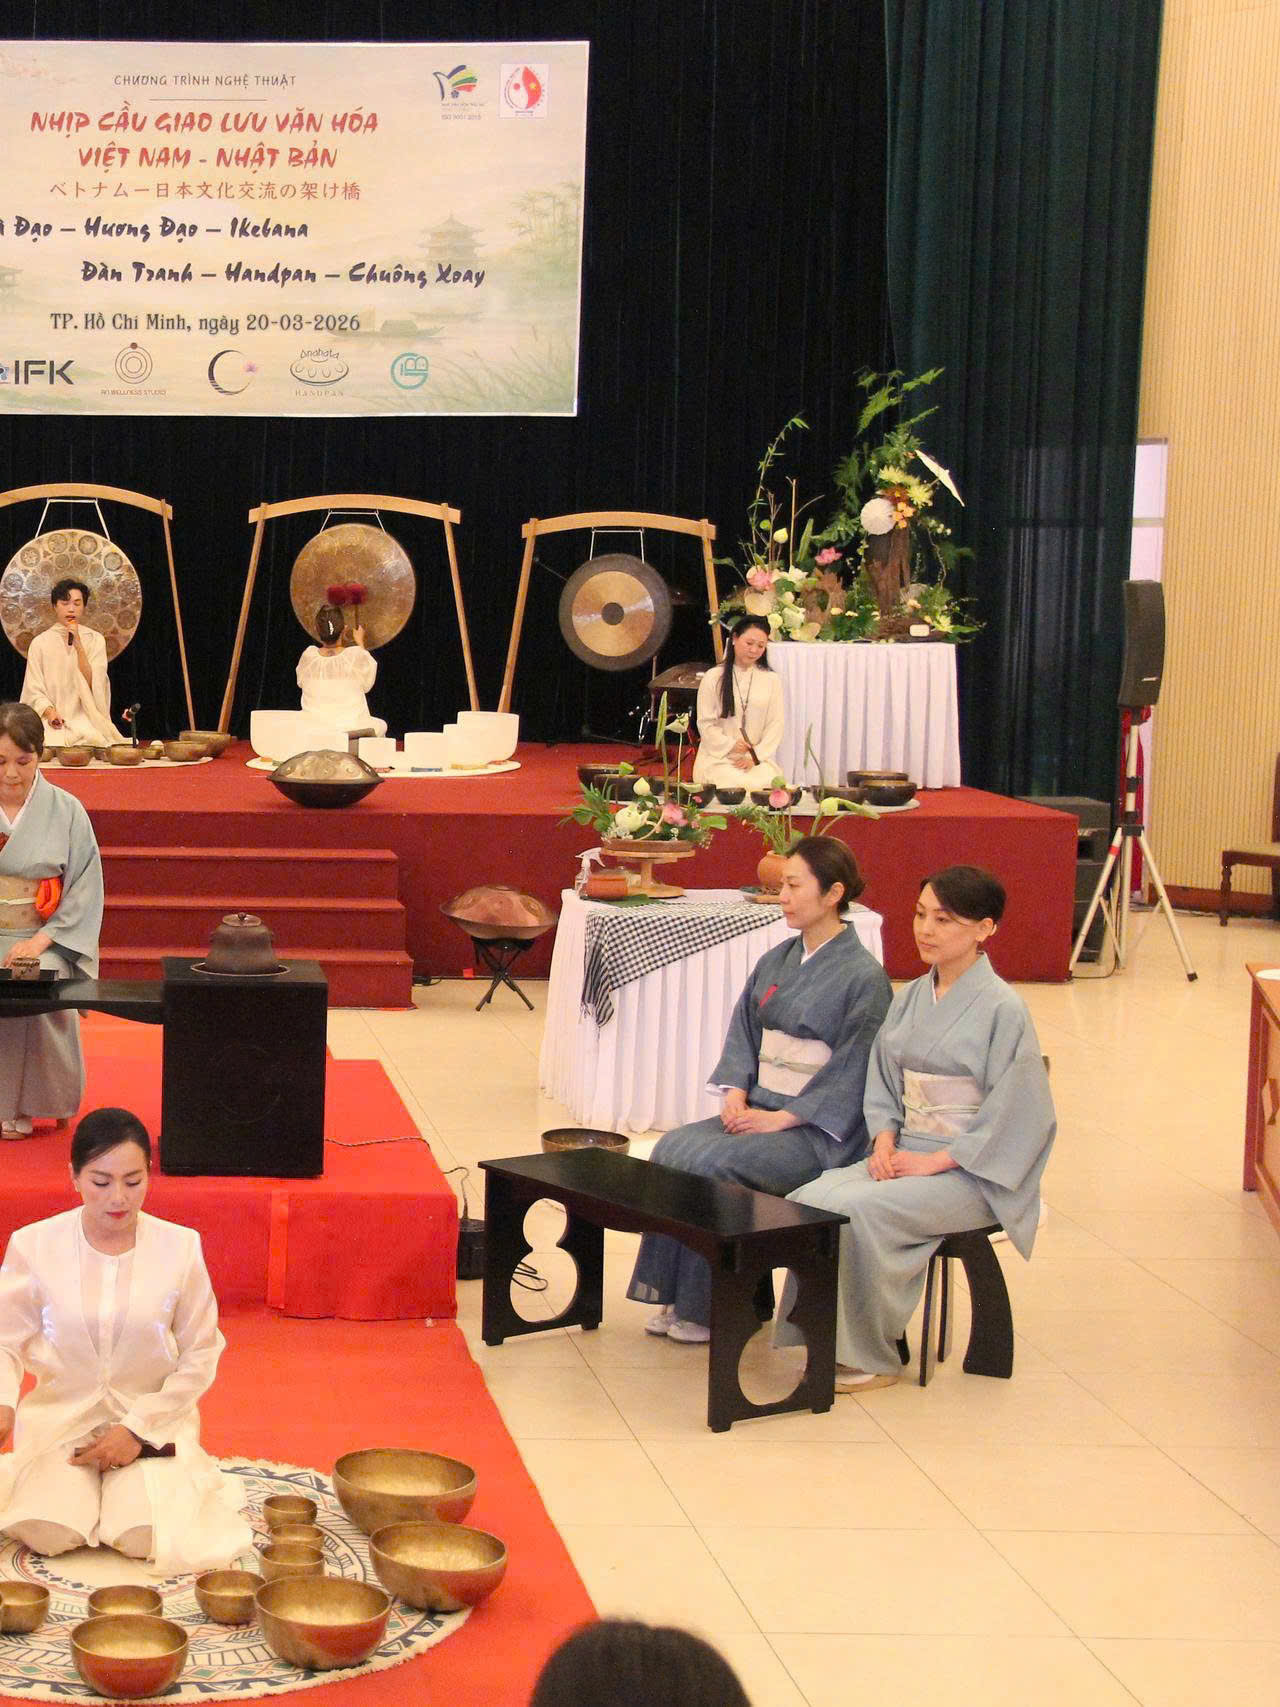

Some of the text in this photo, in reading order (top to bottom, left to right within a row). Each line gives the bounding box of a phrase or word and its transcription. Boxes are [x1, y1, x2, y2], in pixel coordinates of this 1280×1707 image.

[114, 73, 296, 89] CHƯƠNG TRÌNH NGHỆ THUẬT
[31, 112, 90, 138] NHỊP
[98, 101, 147, 133] CẦU
[155, 112, 212, 133] GIAO
[276, 108, 323, 134] VĂN
[331, 107, 378, 134] HÓA
[79, 141, 130, 173] VIỆT
[139, 147, 191, 168] NAM
[216, 142, 280, 174] NHẬT
[288, 140, 337, 168] BẢN
[14, 215, 52, 242] Đạo
[84, 216, 150, 242] Hương
[159, 216, 198, 243] Đạo
[231, 217, 308, 238] Ikebana
[81, 261, 121, 281] Đàn
[132, 262, 192, 283] Tranh
[225, 261, 316, 288] Handpan
[349, 262, 427, 289] Chuông
[436, 263, 485, 288] Xoay
[50, 313, 77, 329] TP.
[85, 312, 105, 329] Hồ
[147, 314, 191, 332] Minh,
[199, 315, 239, 335] ngày
[247, 314, 360, 331] 20-03-2026
[15, 360, 74, 385] IFK
